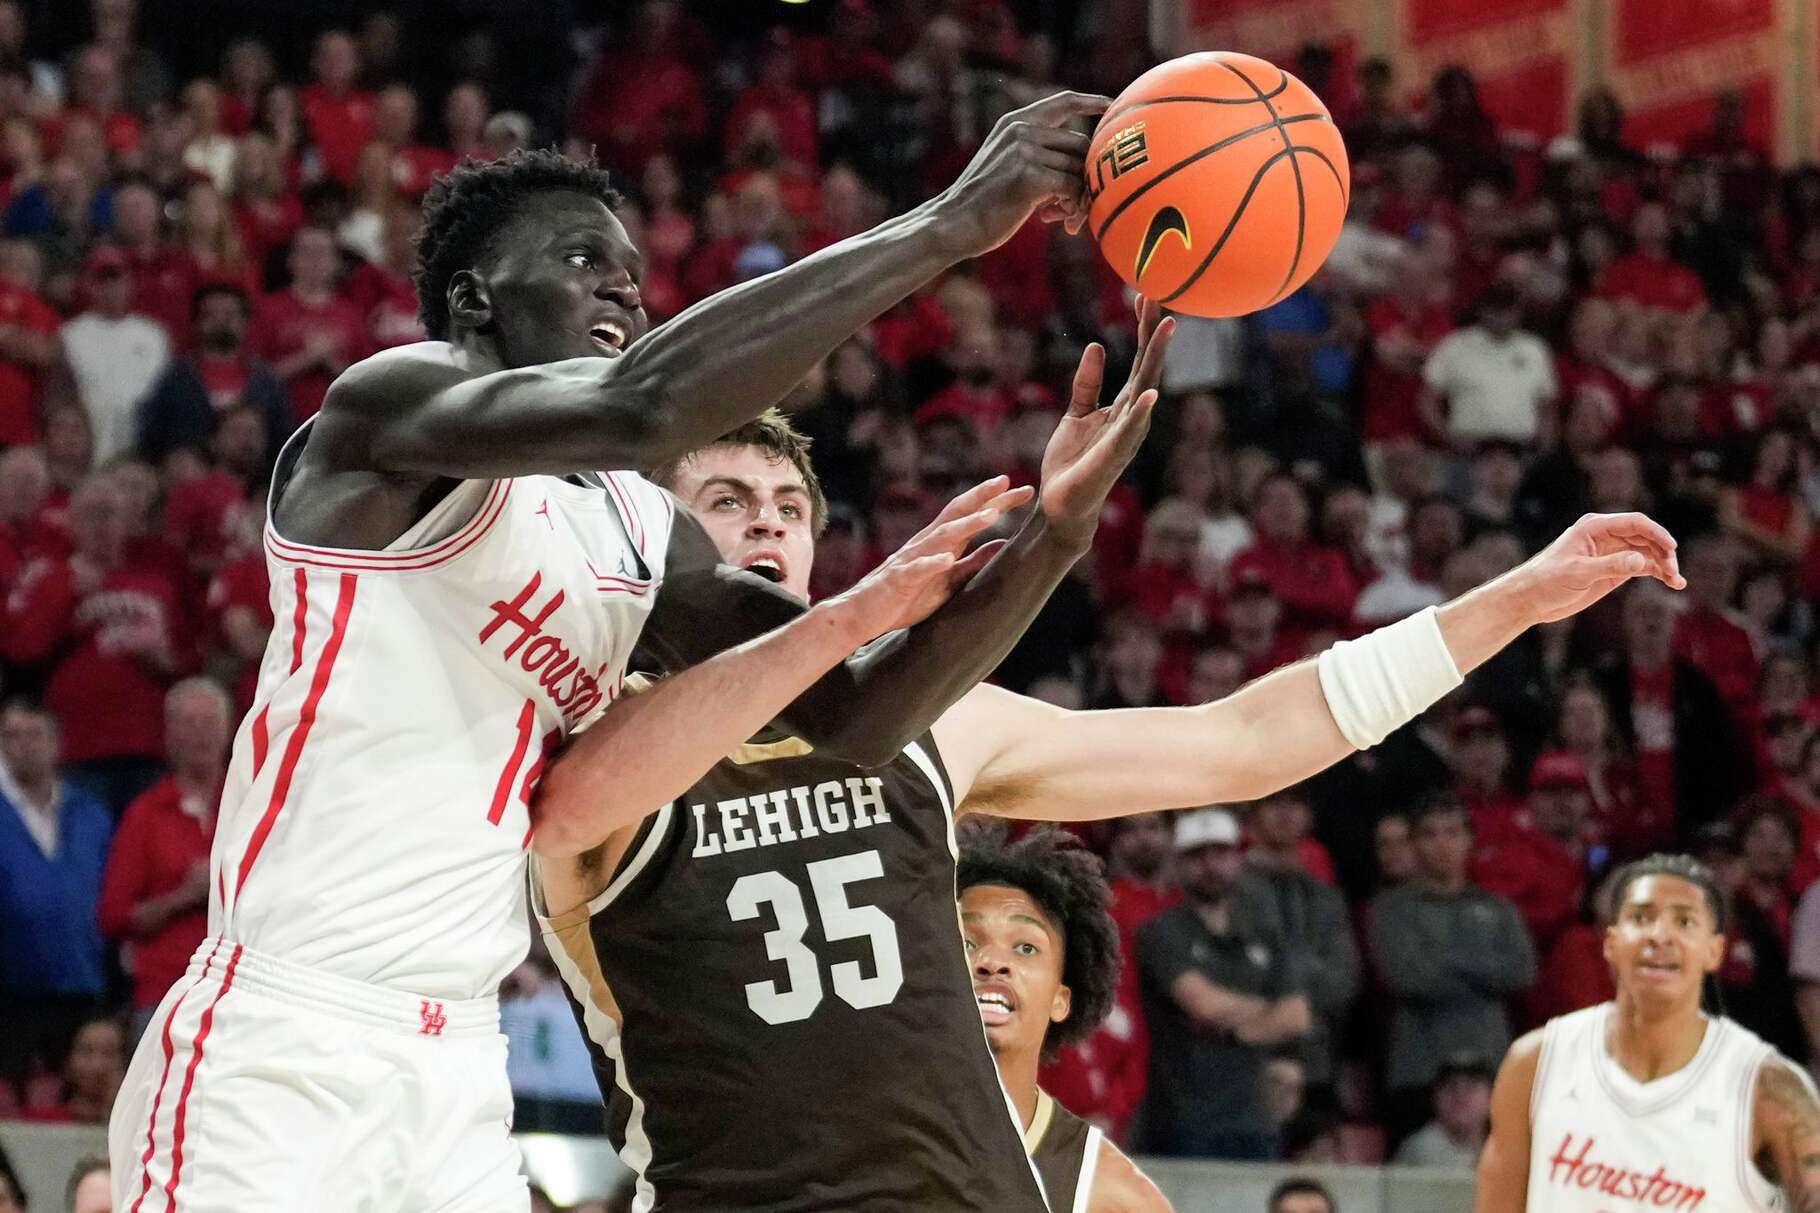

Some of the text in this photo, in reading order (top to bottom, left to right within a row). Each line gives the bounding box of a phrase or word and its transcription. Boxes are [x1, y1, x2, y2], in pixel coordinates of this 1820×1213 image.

[691, 776, 892, 858] LEHIGH
[725, 849, 904, 1025] 35
[1549, 1132, 1706, 1212] Houston
